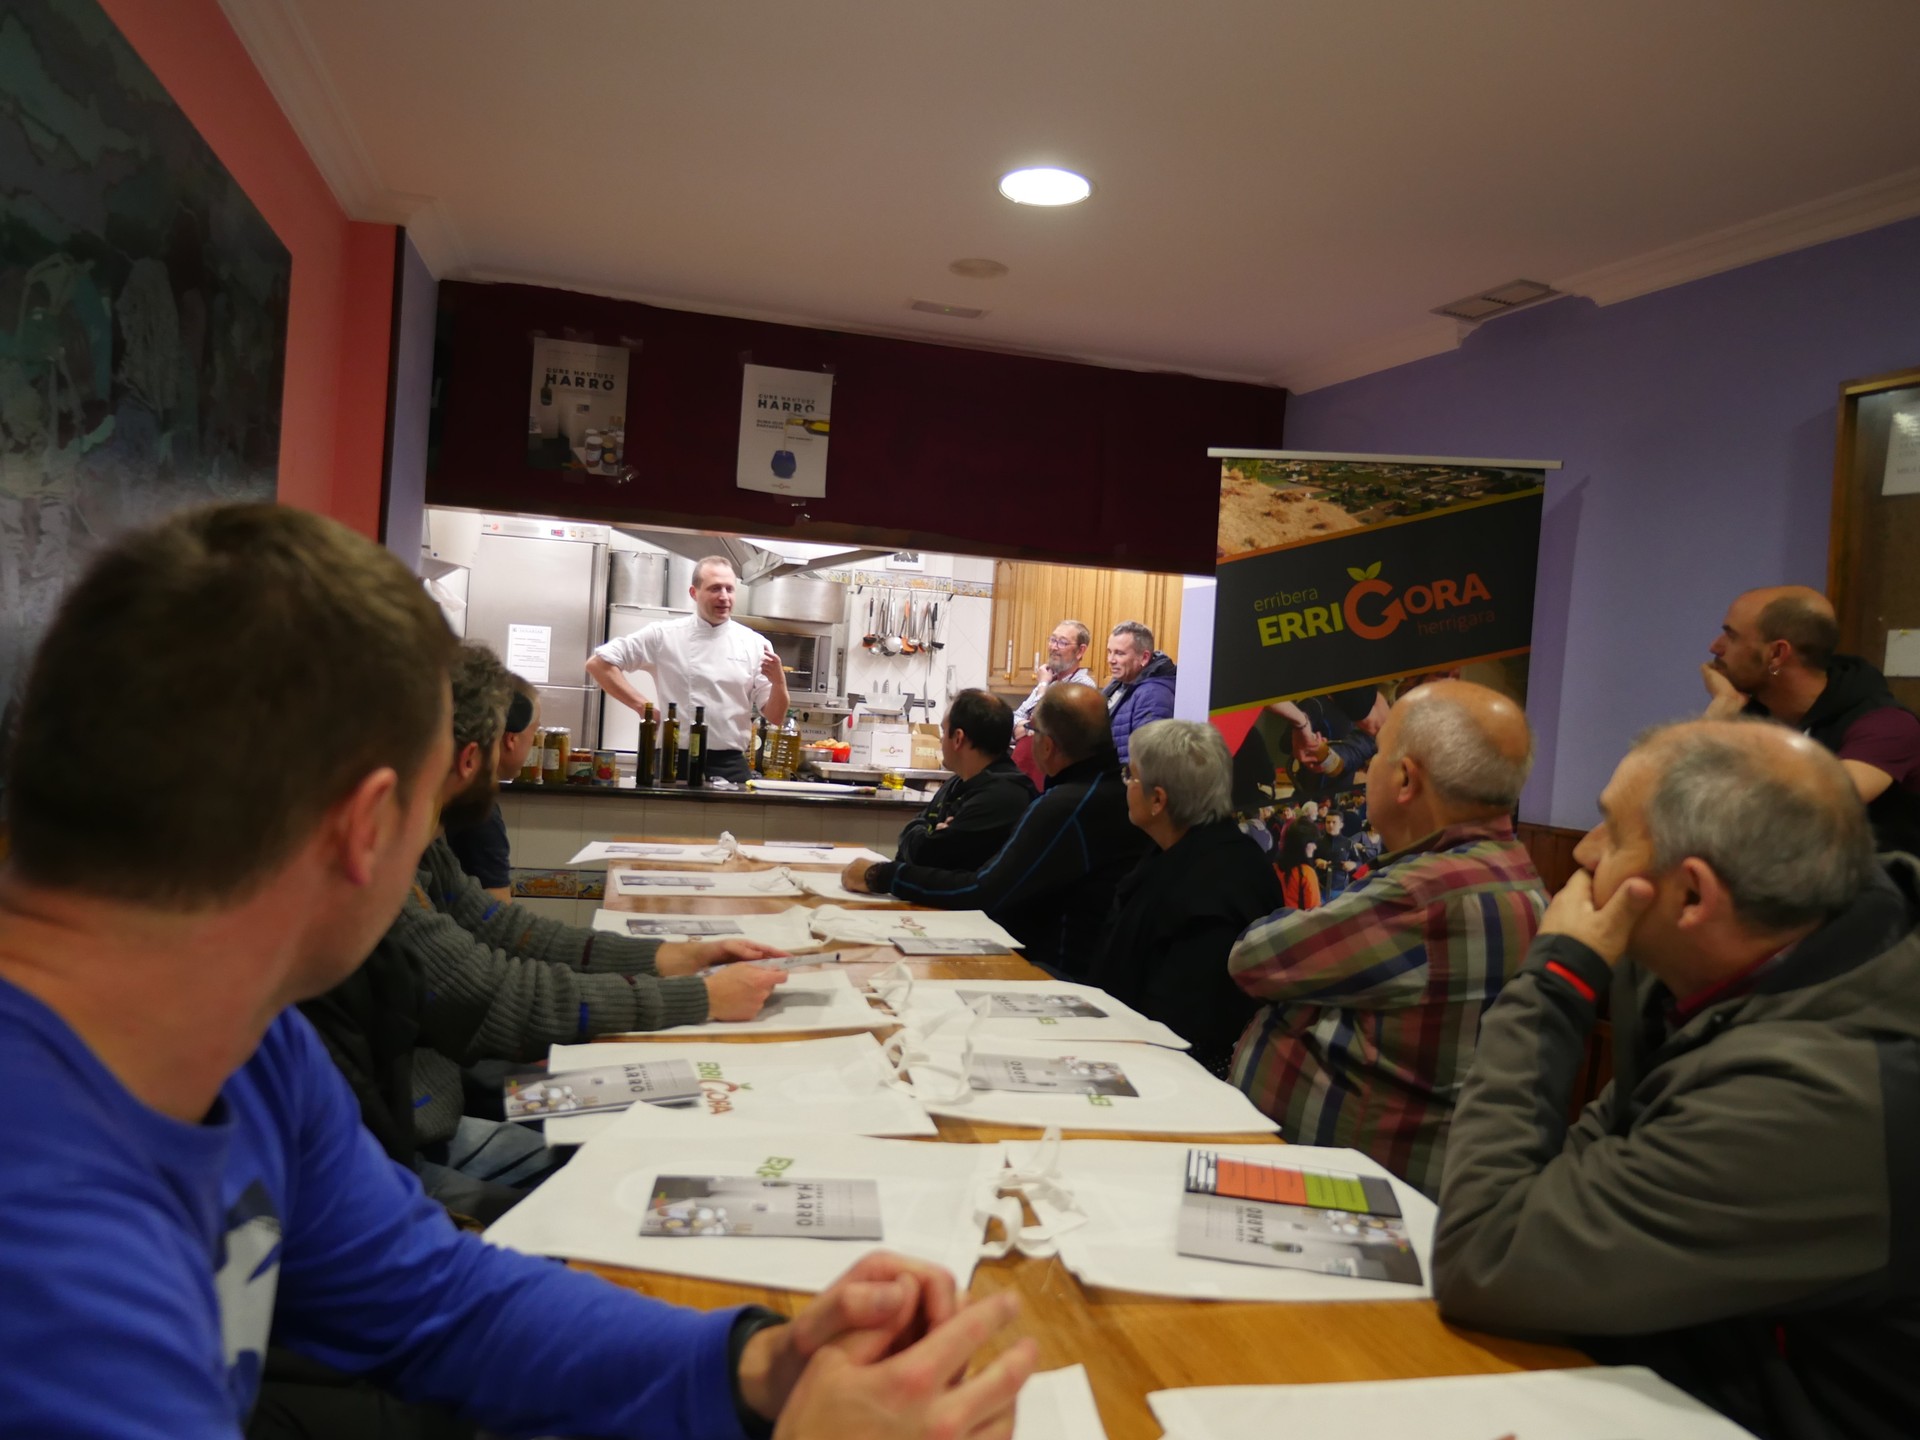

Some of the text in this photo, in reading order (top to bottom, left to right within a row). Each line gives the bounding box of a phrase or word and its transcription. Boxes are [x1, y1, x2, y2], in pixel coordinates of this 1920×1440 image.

[545, 373, 615, 391] HARRO
[757, 399, 815, 413] HARRO
[1253, 586, 1319, 612] erribera
[1257, 573, 1492, 648] ERRIGORA
[1416, 609, 1496, 638] herrigara
[623, 1064, 646, 1093] ARRO
[796, 1183, 814, 1227] HARRO
[1247, 1207, 1264, 1244] HARRO
